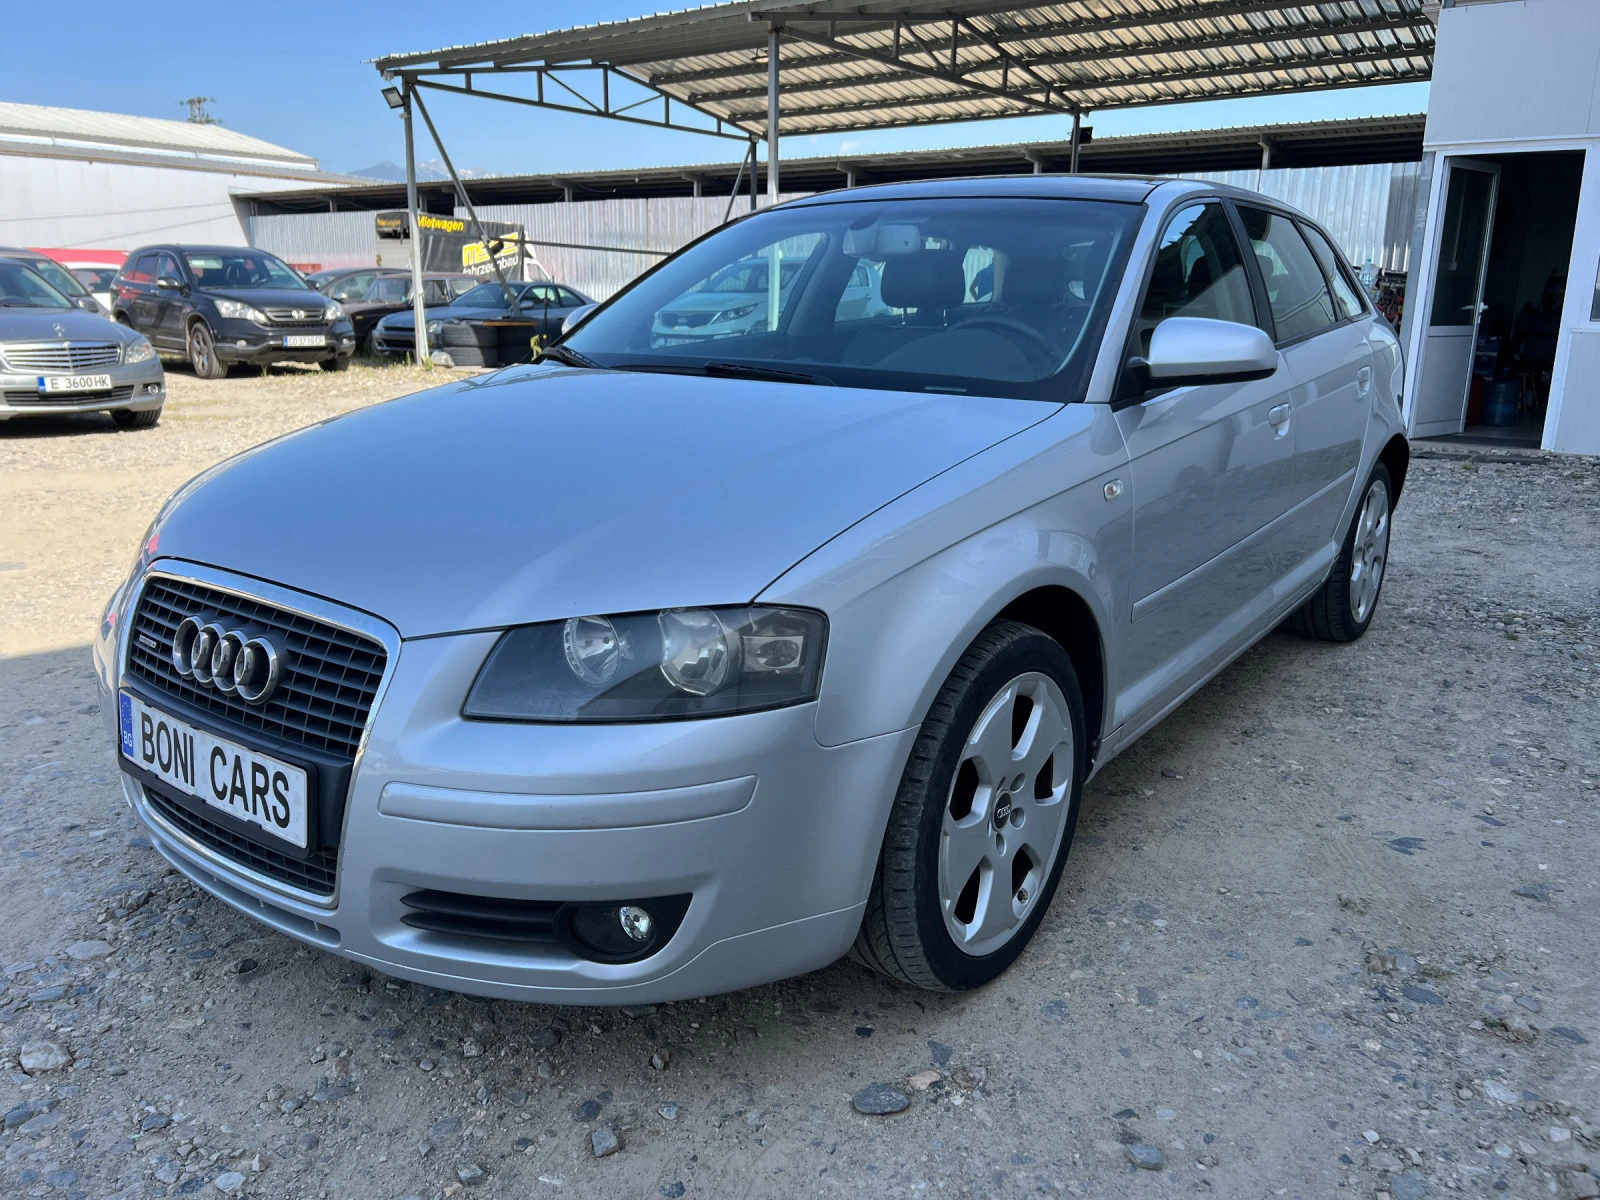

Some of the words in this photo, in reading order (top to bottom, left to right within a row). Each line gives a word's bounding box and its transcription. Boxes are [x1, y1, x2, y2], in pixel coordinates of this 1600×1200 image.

[50, 378, 60, 389] E
[65, 377, 93, 388] 3600
[95, 376, 109, 387] HK
[123, 730, 133, 747] BG
[140, 711, 196, 787] BONI
[209, 745, 291, 829] CARS
